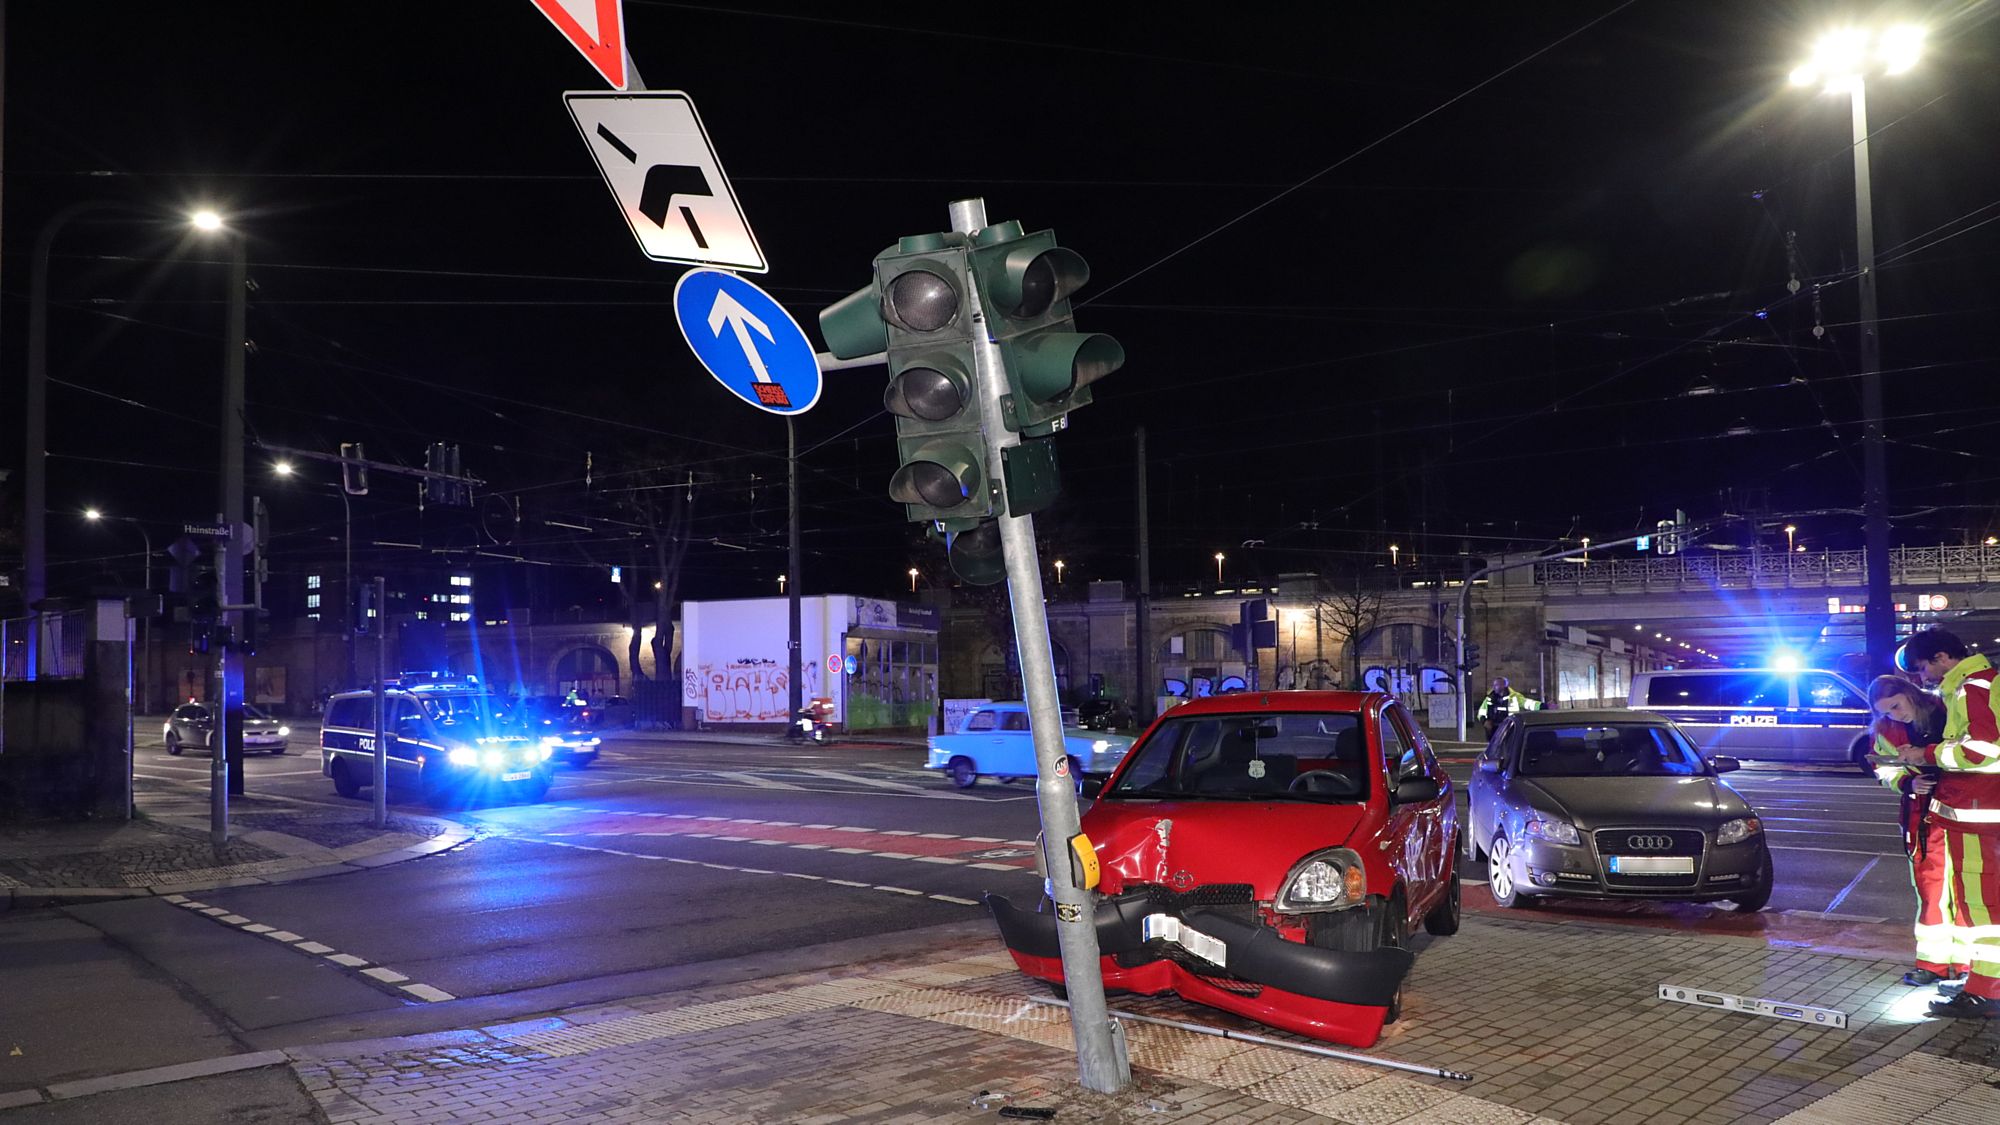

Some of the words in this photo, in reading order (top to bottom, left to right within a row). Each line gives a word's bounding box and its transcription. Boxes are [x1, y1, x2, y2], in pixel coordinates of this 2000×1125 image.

[1051, 417, 1066, 432] F8
[184, 524, 230, 536] Hainstraße
[1730, 715, 1778, 727] POLIZEI
[358, 738, 376, 751] POLI
